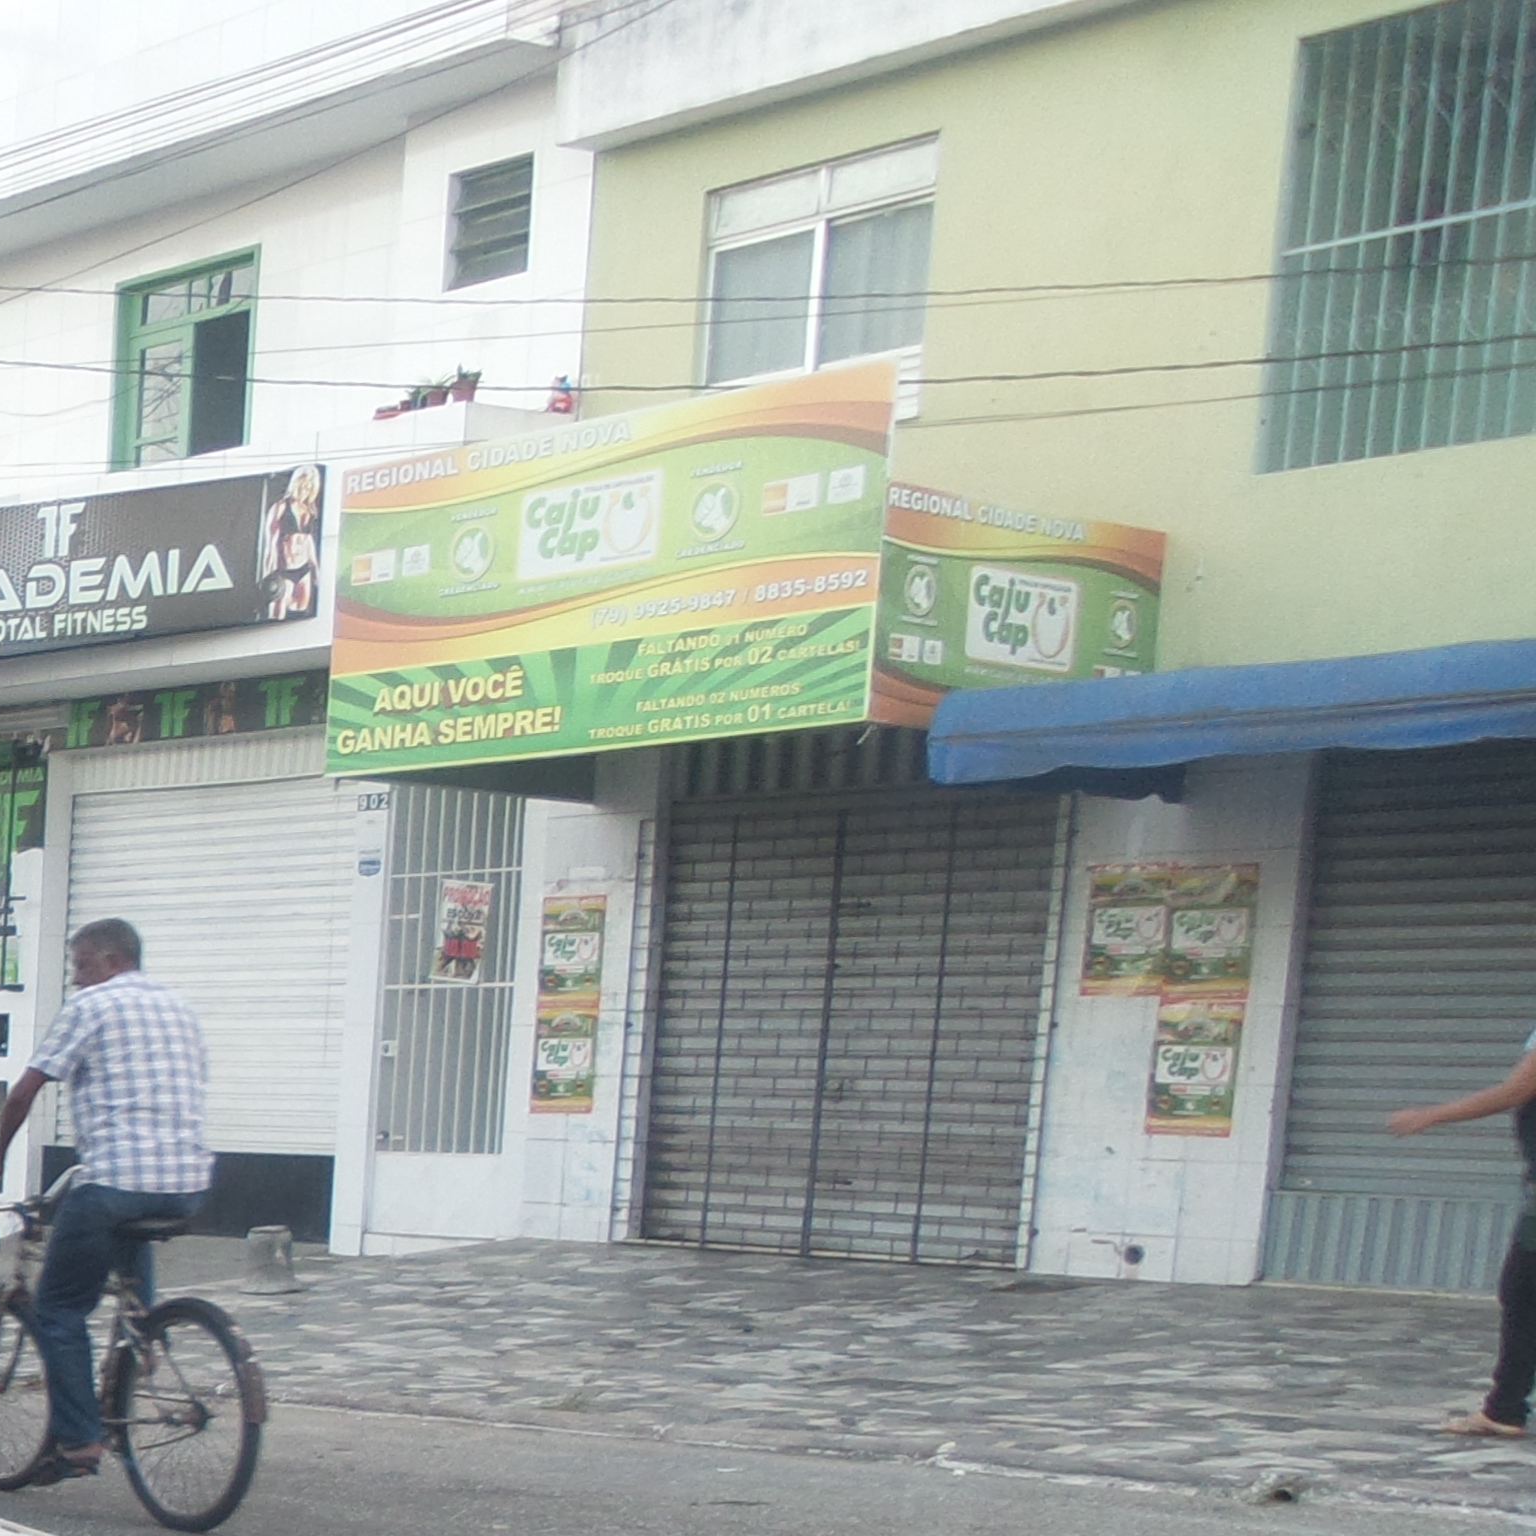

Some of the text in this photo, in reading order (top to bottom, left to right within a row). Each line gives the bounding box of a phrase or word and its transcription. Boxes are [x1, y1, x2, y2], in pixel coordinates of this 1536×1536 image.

[345, 420, 631, 495] REGIONAL CIDADE NOVA
[525, 488, 601, 532] Caju
[888, 486, 1086, 541] REGIONAL CIDADE NOVA
[538, 527, 601, 562] Cap
[590, 606, 628, 629] (79)
[754, 569, 869, 602] 8835-8592
[972, 573, 1031, 625] Caju
[53, 605, 147, 638] FITNESS
[982, 609, 1029, 656] Cap
[590, 667, 643, 684] TROQUE
[714, 656, 744, 669] POR
[747, 646, 773, 666] 02
[777, 640, 861, 662] CARTELAS!
[637, 635, 721, 657] FALTANDO
[373, 665, 525, 715] AQUI VOCÊ
[636, 694, 705, 713] FALTANDO
[337, 706, 563, 756] GANHA SEMPRE!
[588, 723, 643, 740] TROQUE
[715, 712, 743, 726] POR
[747, 703, 771, 722] 01
[359, 793, 389, 811] 902
